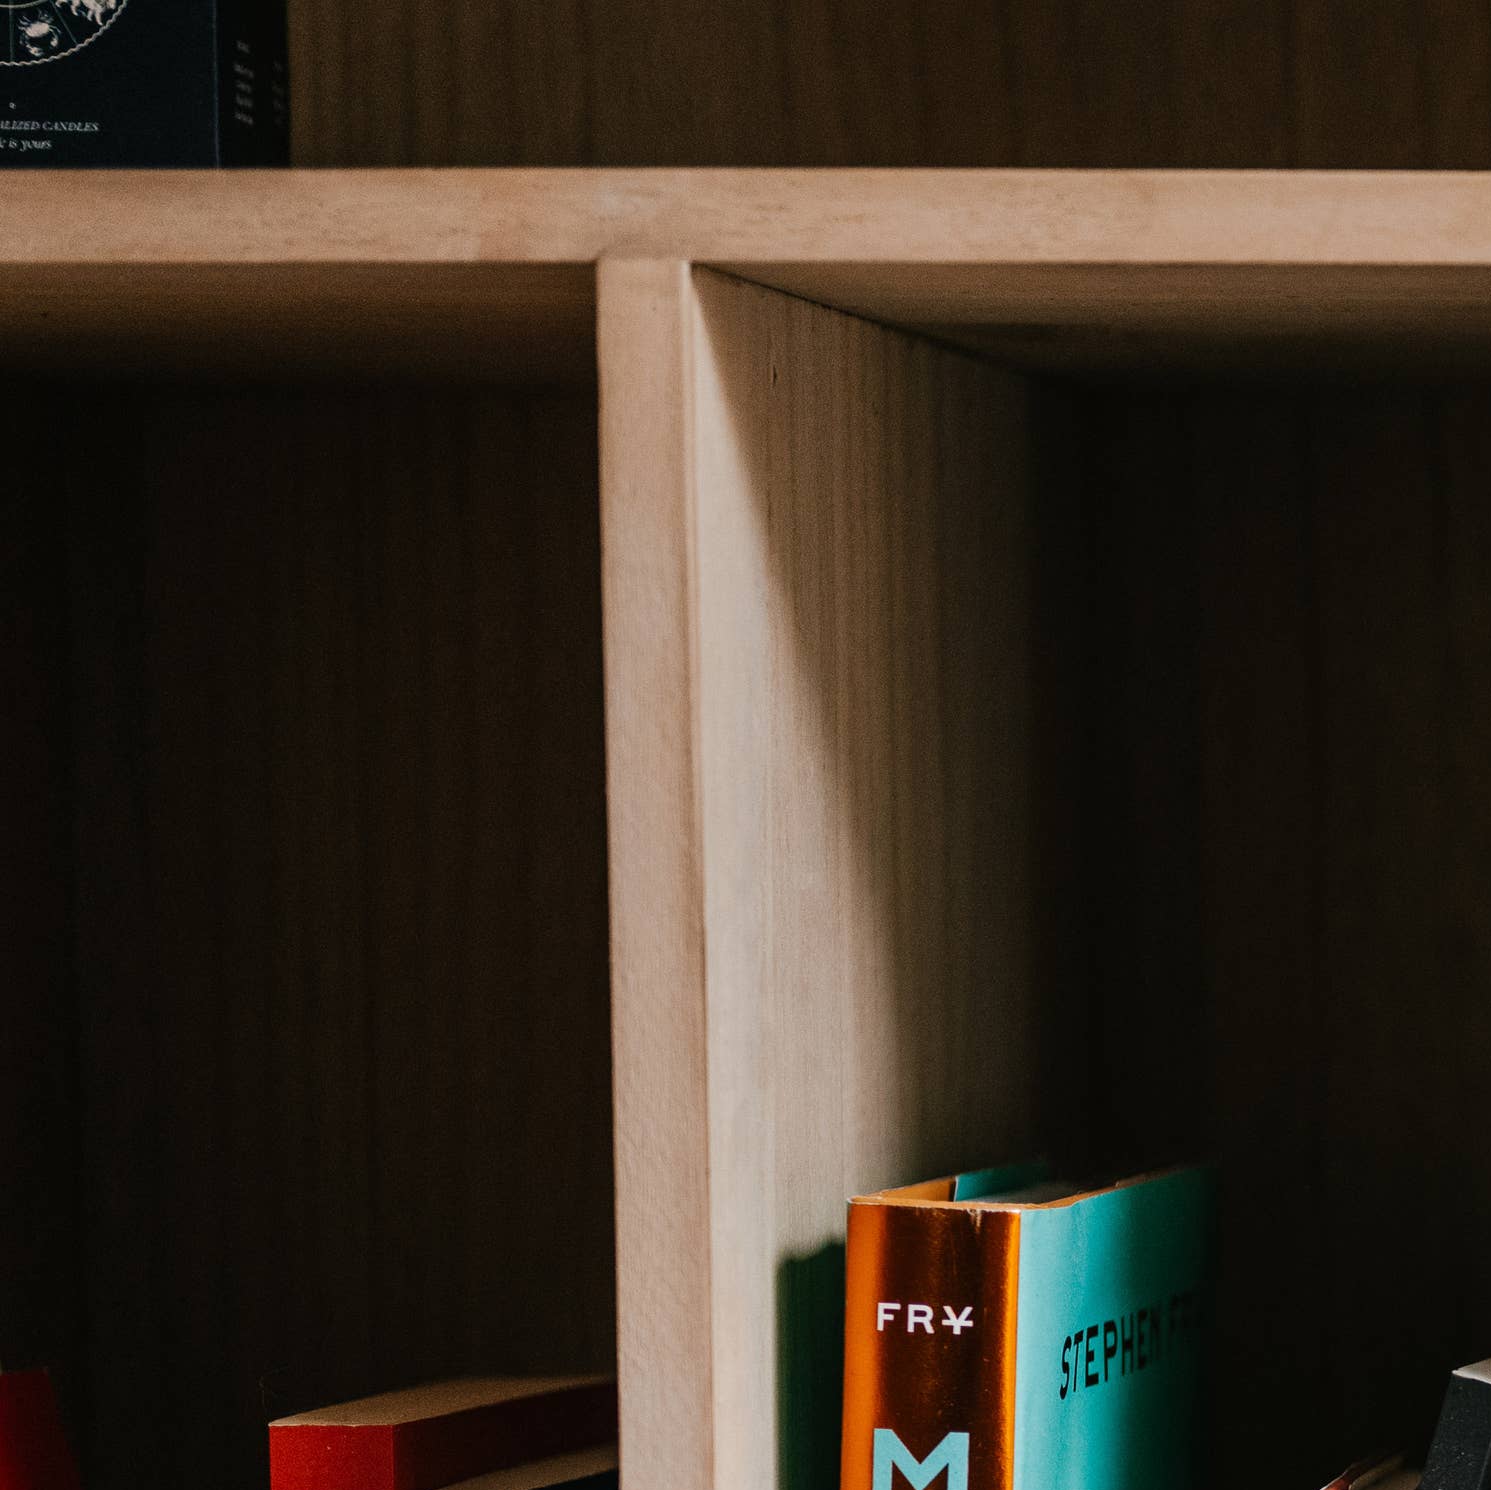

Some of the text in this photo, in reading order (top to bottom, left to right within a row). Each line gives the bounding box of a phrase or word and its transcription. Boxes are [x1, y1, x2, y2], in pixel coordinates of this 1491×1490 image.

[42, 121, 100, 132] CANDLES
[20, 139, 53, 153] yours
[876, 1301, 974, 1335] FRY
